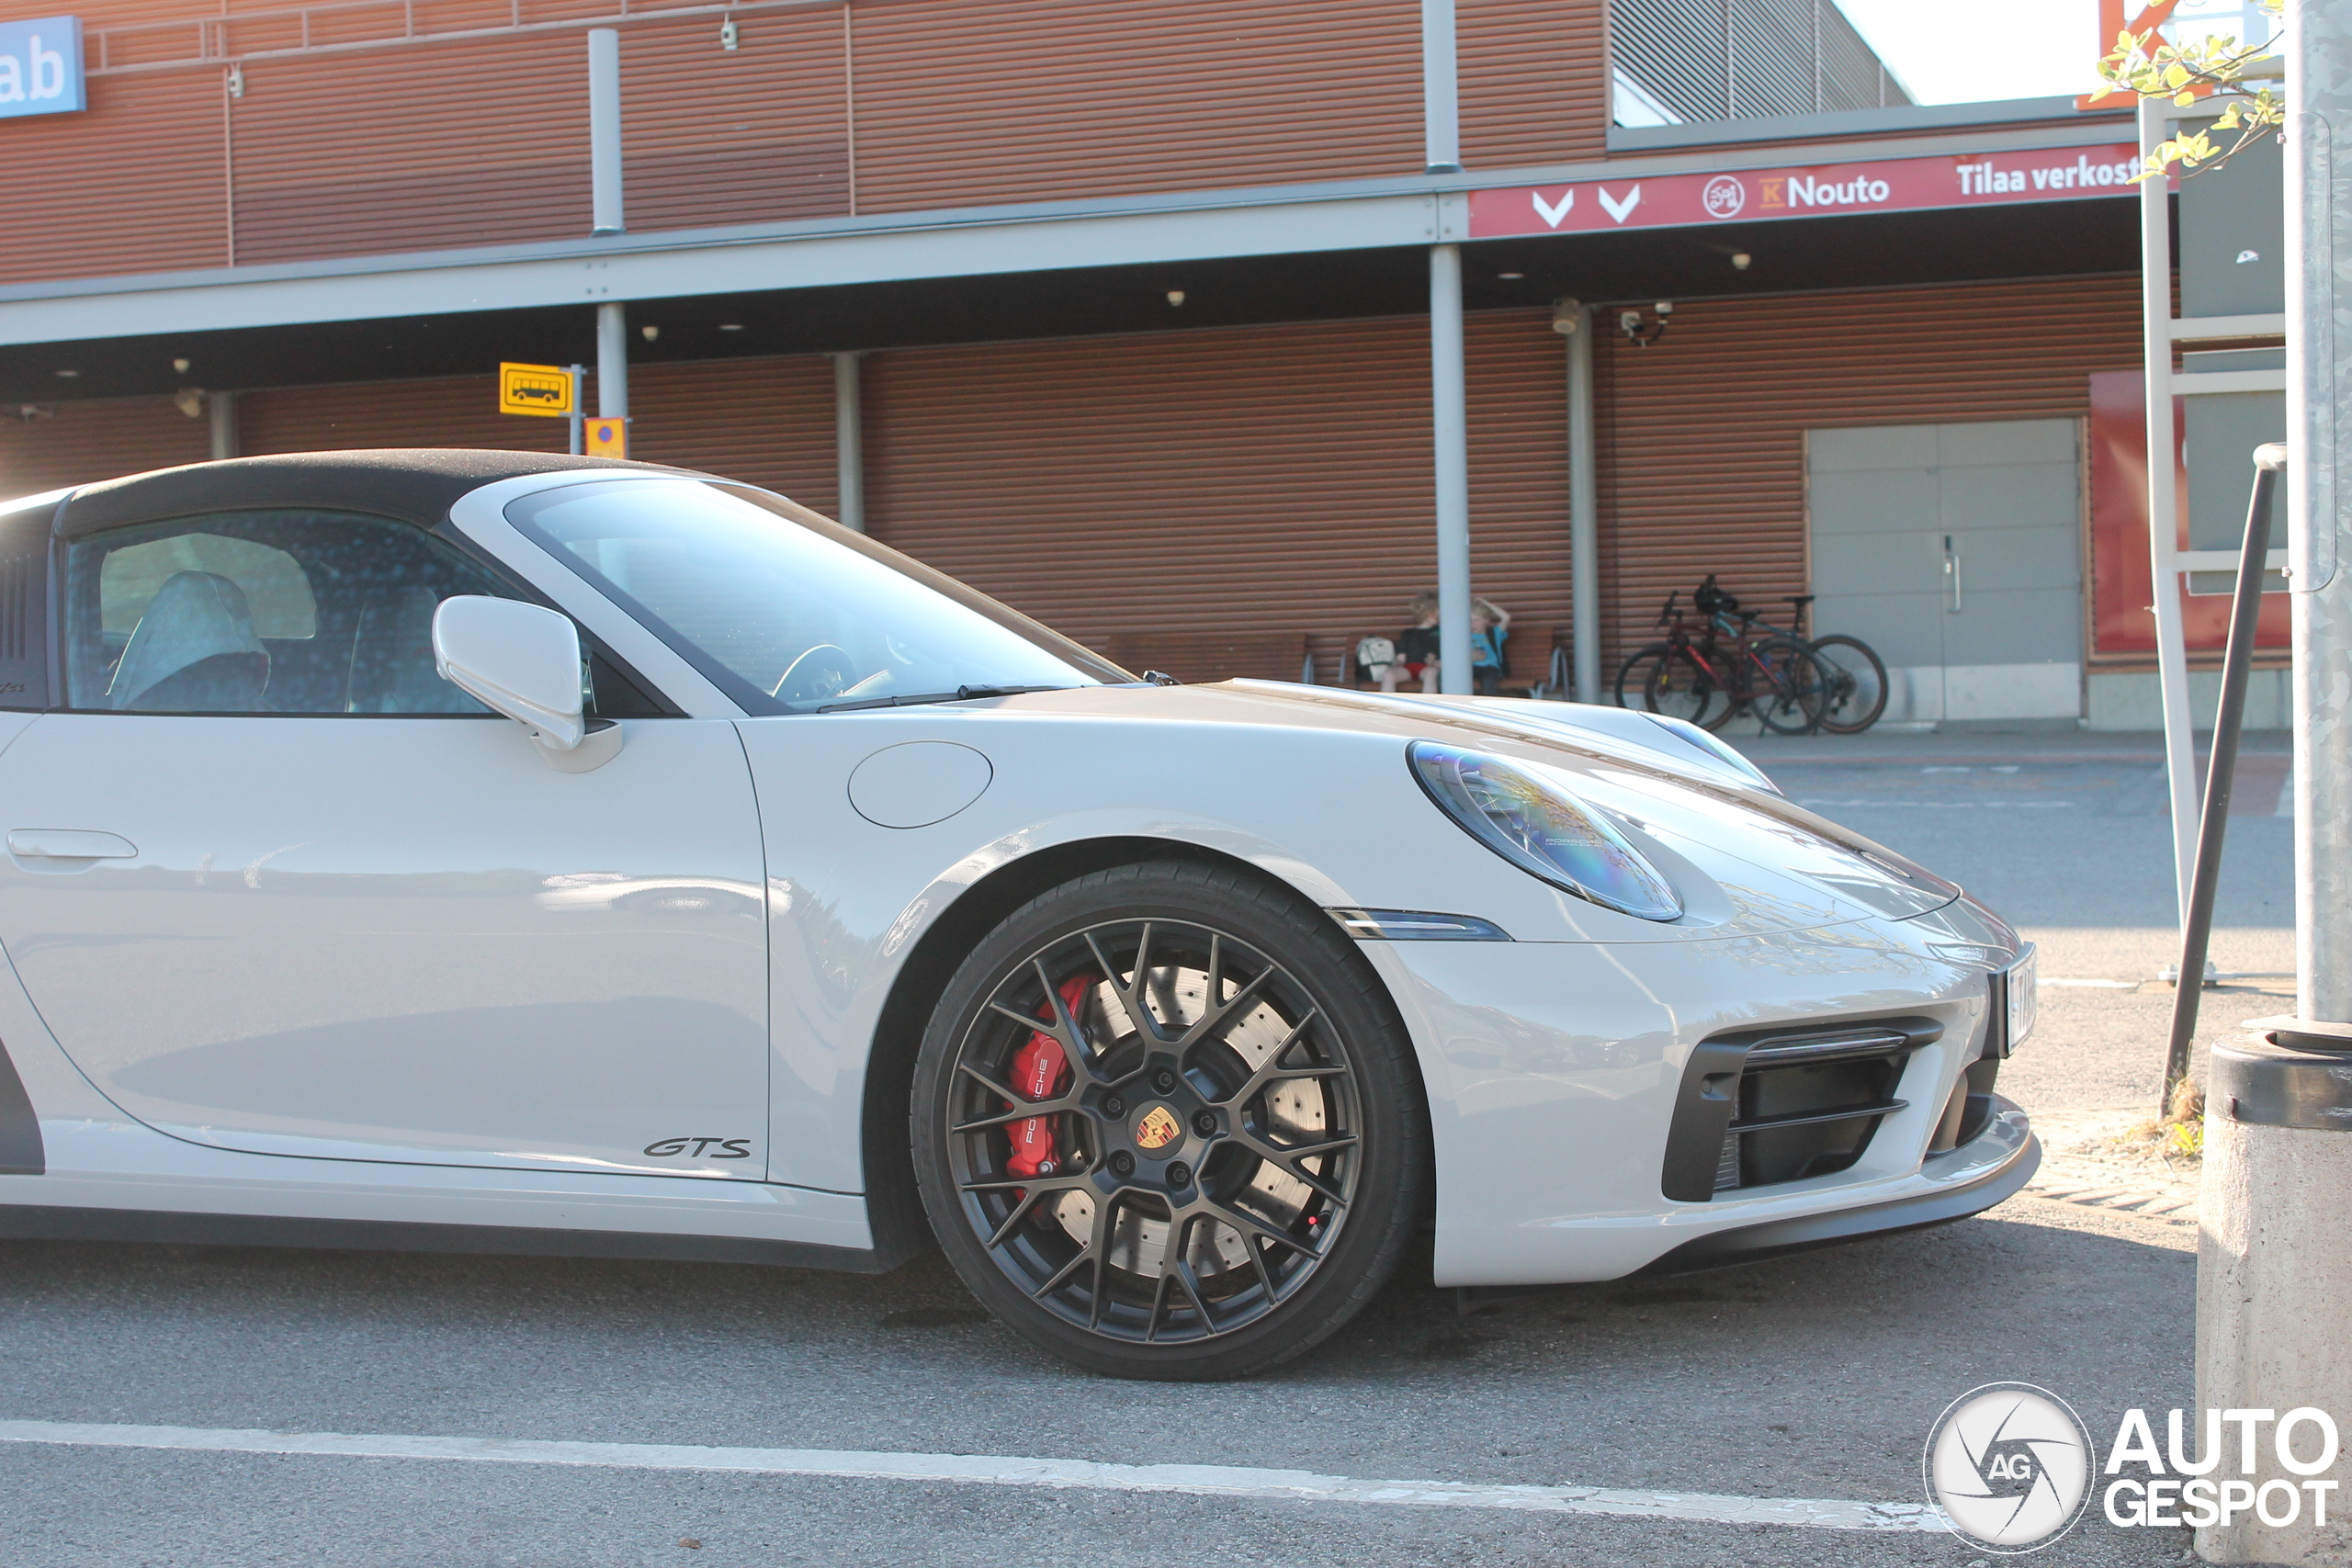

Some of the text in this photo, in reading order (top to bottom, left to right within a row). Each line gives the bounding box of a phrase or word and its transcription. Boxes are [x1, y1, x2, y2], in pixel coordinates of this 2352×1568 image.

[0, 34, 64, 103] ab
[1788, 175, 1890, 208] Nouto
[1956, 154, 2170, 195] Tilaa verkost
[1025, 1057, 1048, 1145] POCHE
[643, 1137, 752, 1158] GTS
